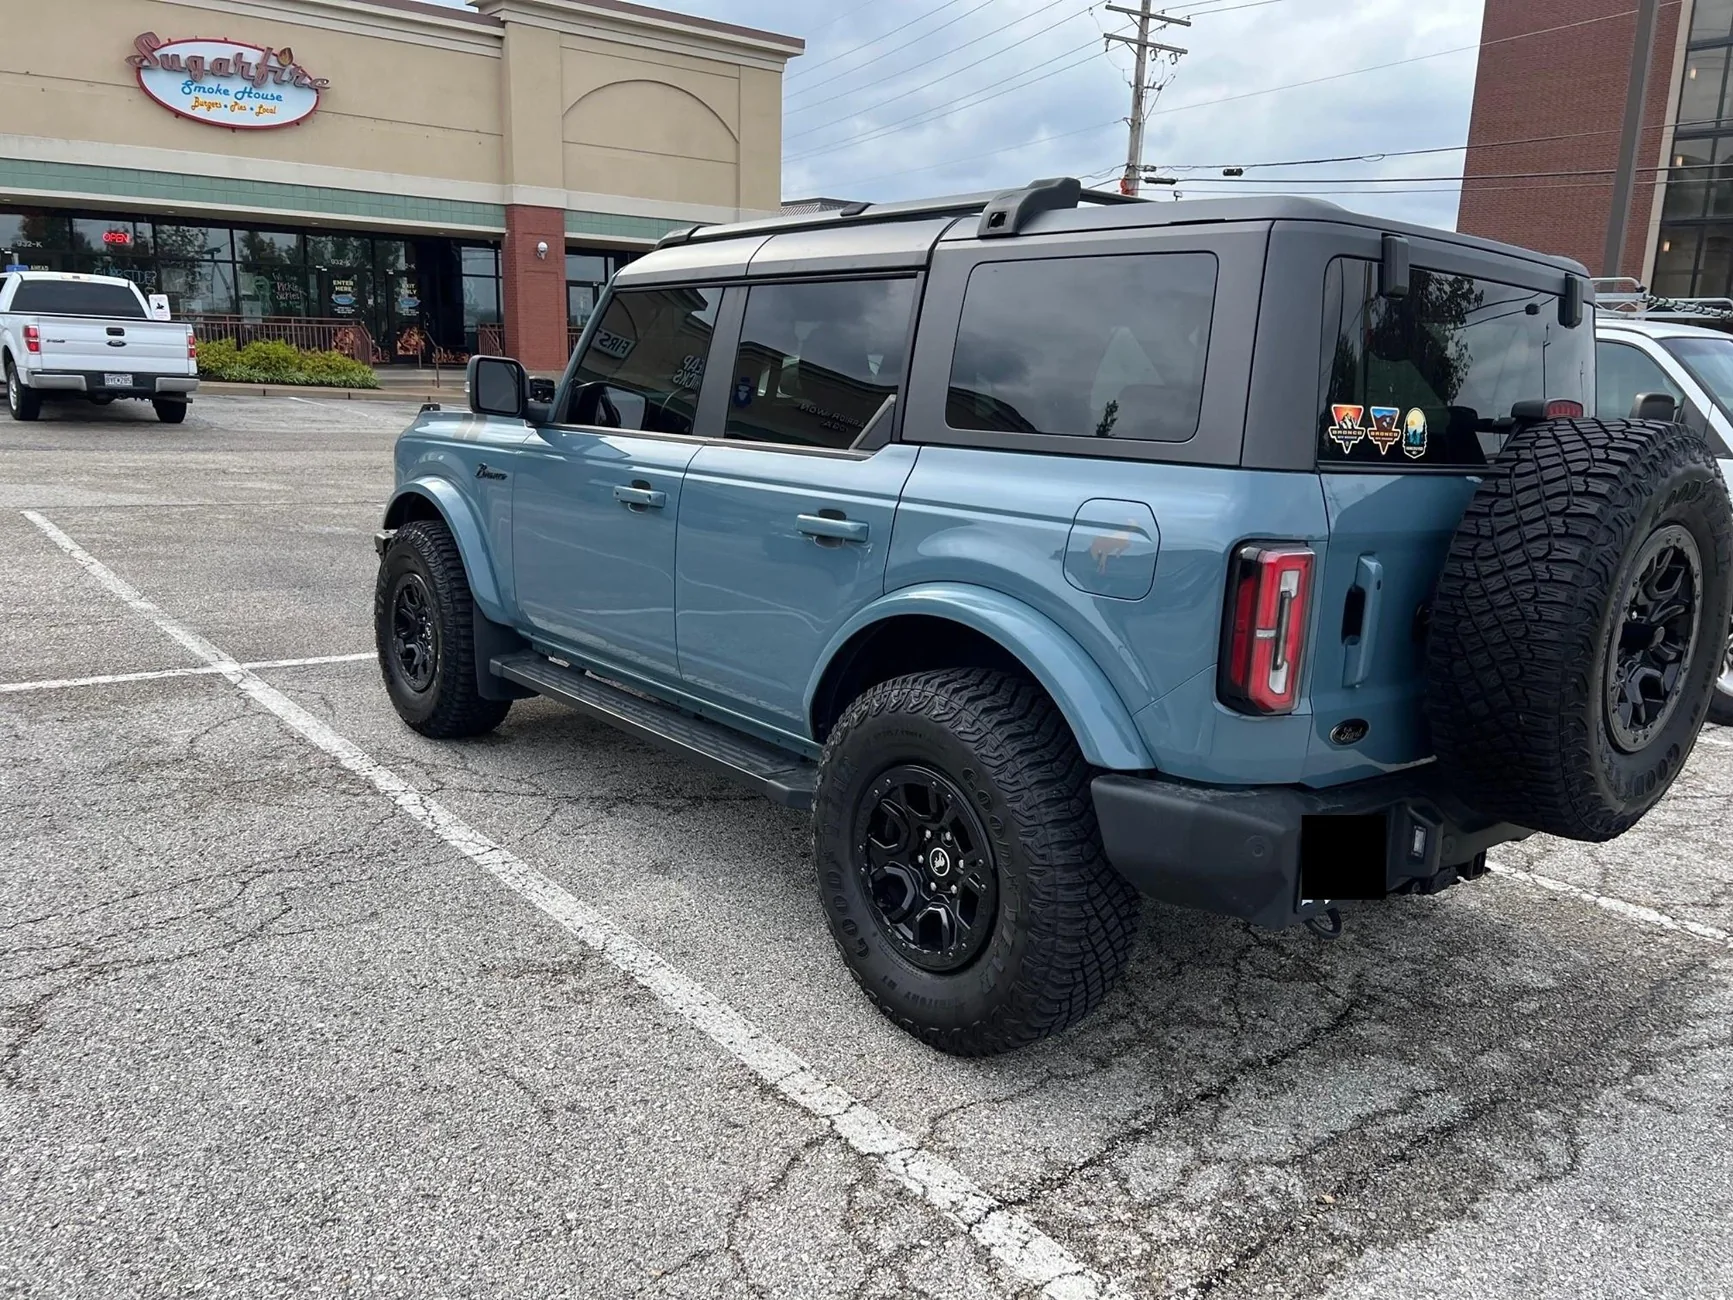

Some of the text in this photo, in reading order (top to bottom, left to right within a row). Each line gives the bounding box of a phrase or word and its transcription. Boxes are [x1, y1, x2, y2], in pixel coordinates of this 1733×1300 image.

[125, 31, 331, 90] Sugarfire
[181, 79, 283, 102] Smoke House
[191, 96, 277, 116] Burgers Pies Local
[103, 232, 130, 243] OPEN
